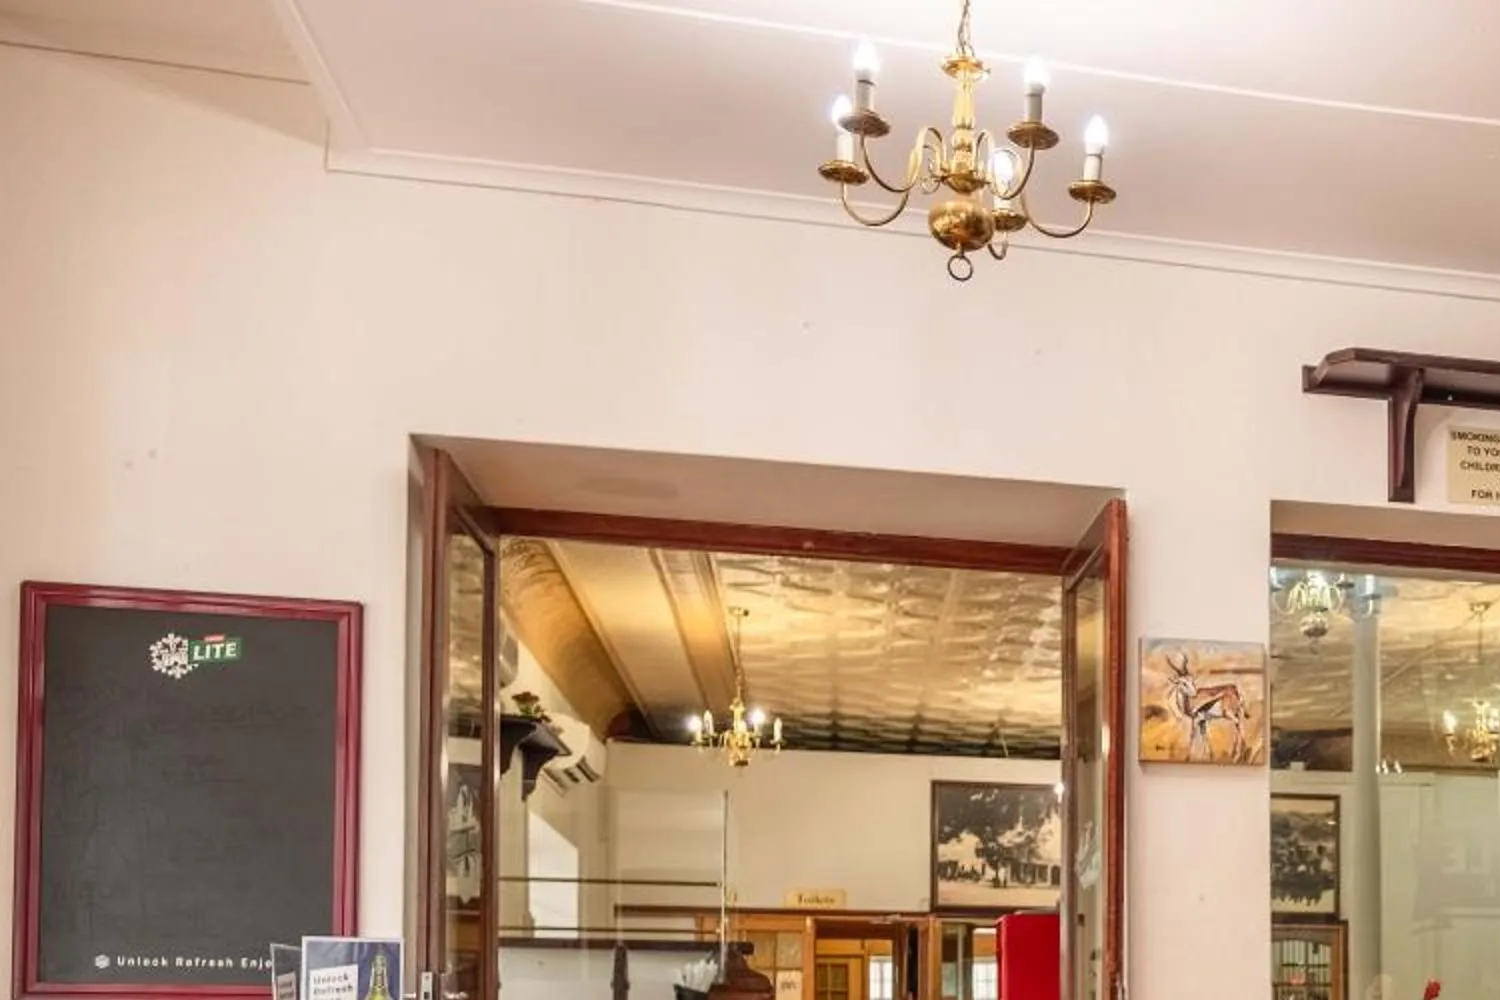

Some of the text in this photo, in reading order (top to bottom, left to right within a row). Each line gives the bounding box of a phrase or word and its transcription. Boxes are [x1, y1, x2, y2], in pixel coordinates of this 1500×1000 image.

[1451, 431, 1500, 443] SMOKING
[1467, 445, 1481, 456] TO
[1471, 489, 1492, 499] FOR
[193, 642, 237, 661] LITE
[117, 956, 272, 971] Unlock Refresh Enjo
